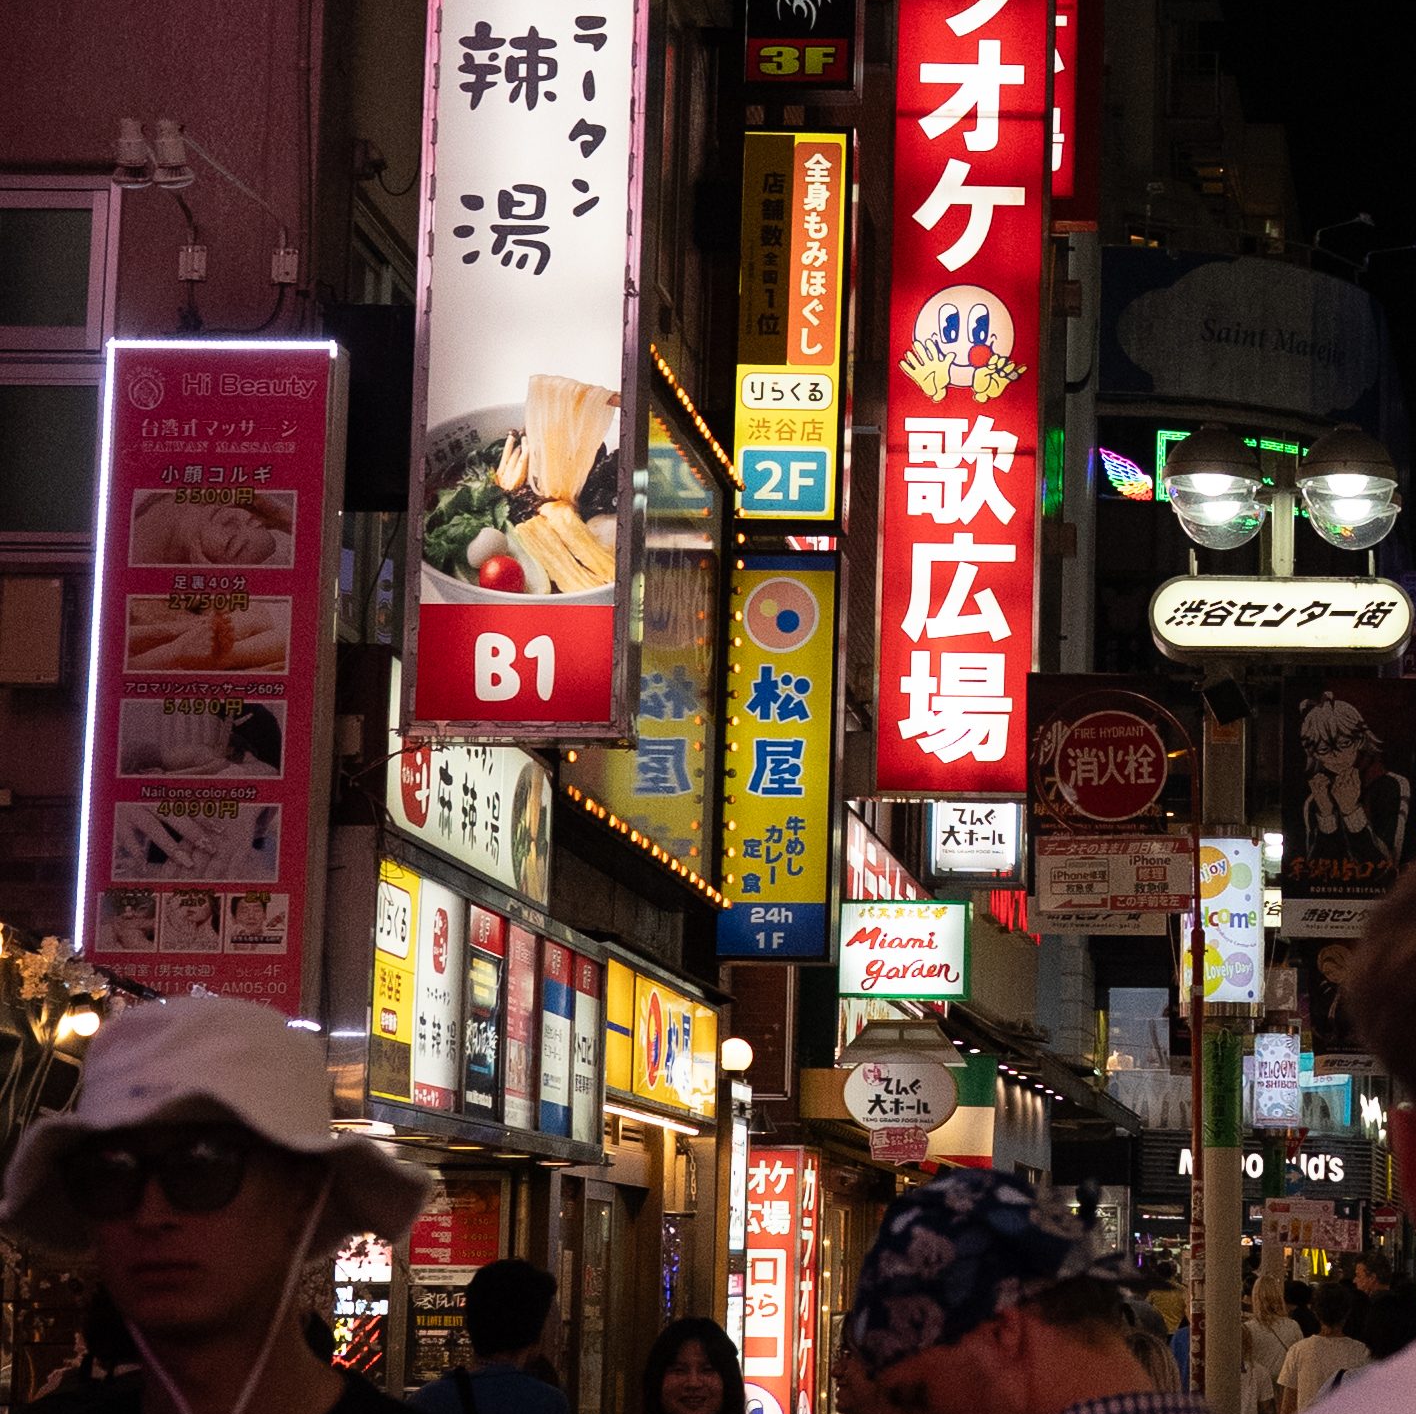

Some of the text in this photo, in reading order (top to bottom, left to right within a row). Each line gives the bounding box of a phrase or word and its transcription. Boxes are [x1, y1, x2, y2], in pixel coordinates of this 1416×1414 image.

[758, 45, 837, 76] 3F
[798, 152, 833, 356] 全身もみほぐし
[181, 372, 318, 400] Hi Beauty
[749, 380, 825, 403] りらくる
[747, 417, 825, 443] 渋谷店
[753, 459, 818, 502] 2F
[897, 414, 1019, 765] 歌広場
[1165, 600, 1398, 629] 渋谷センター街
[474, 631, 556, 702] B1
[745, 662, 813, 799] 松屋
[1073, 725, 1145, 740] FIRE HYDRANT
[1066, 743, 1157, 788] 消火栓
[952, 807, 997, 826] てんぐ
[785, 816, 806, 877] 牛めし
[940, 825, 1006, 847] 大ホール
[740, 838, 763, 895] 定食
[763, 824, 784, 885] カレー
[1128, 854, 1172, 867] iPhone
[1140, 867, 1166, 880] 修理
[750, 906, 793, 925] 24h
[1183, 905, 1258, 930] Wlcome
[755, 932, 785, 950] 1F
[845, 926, 939, 950] Miami
[879, 1077, 922, 1096] てんぐ
[867, 1093, 932, 1116] 大ホール
[800, 1157, 816, 1381] カラオケ
